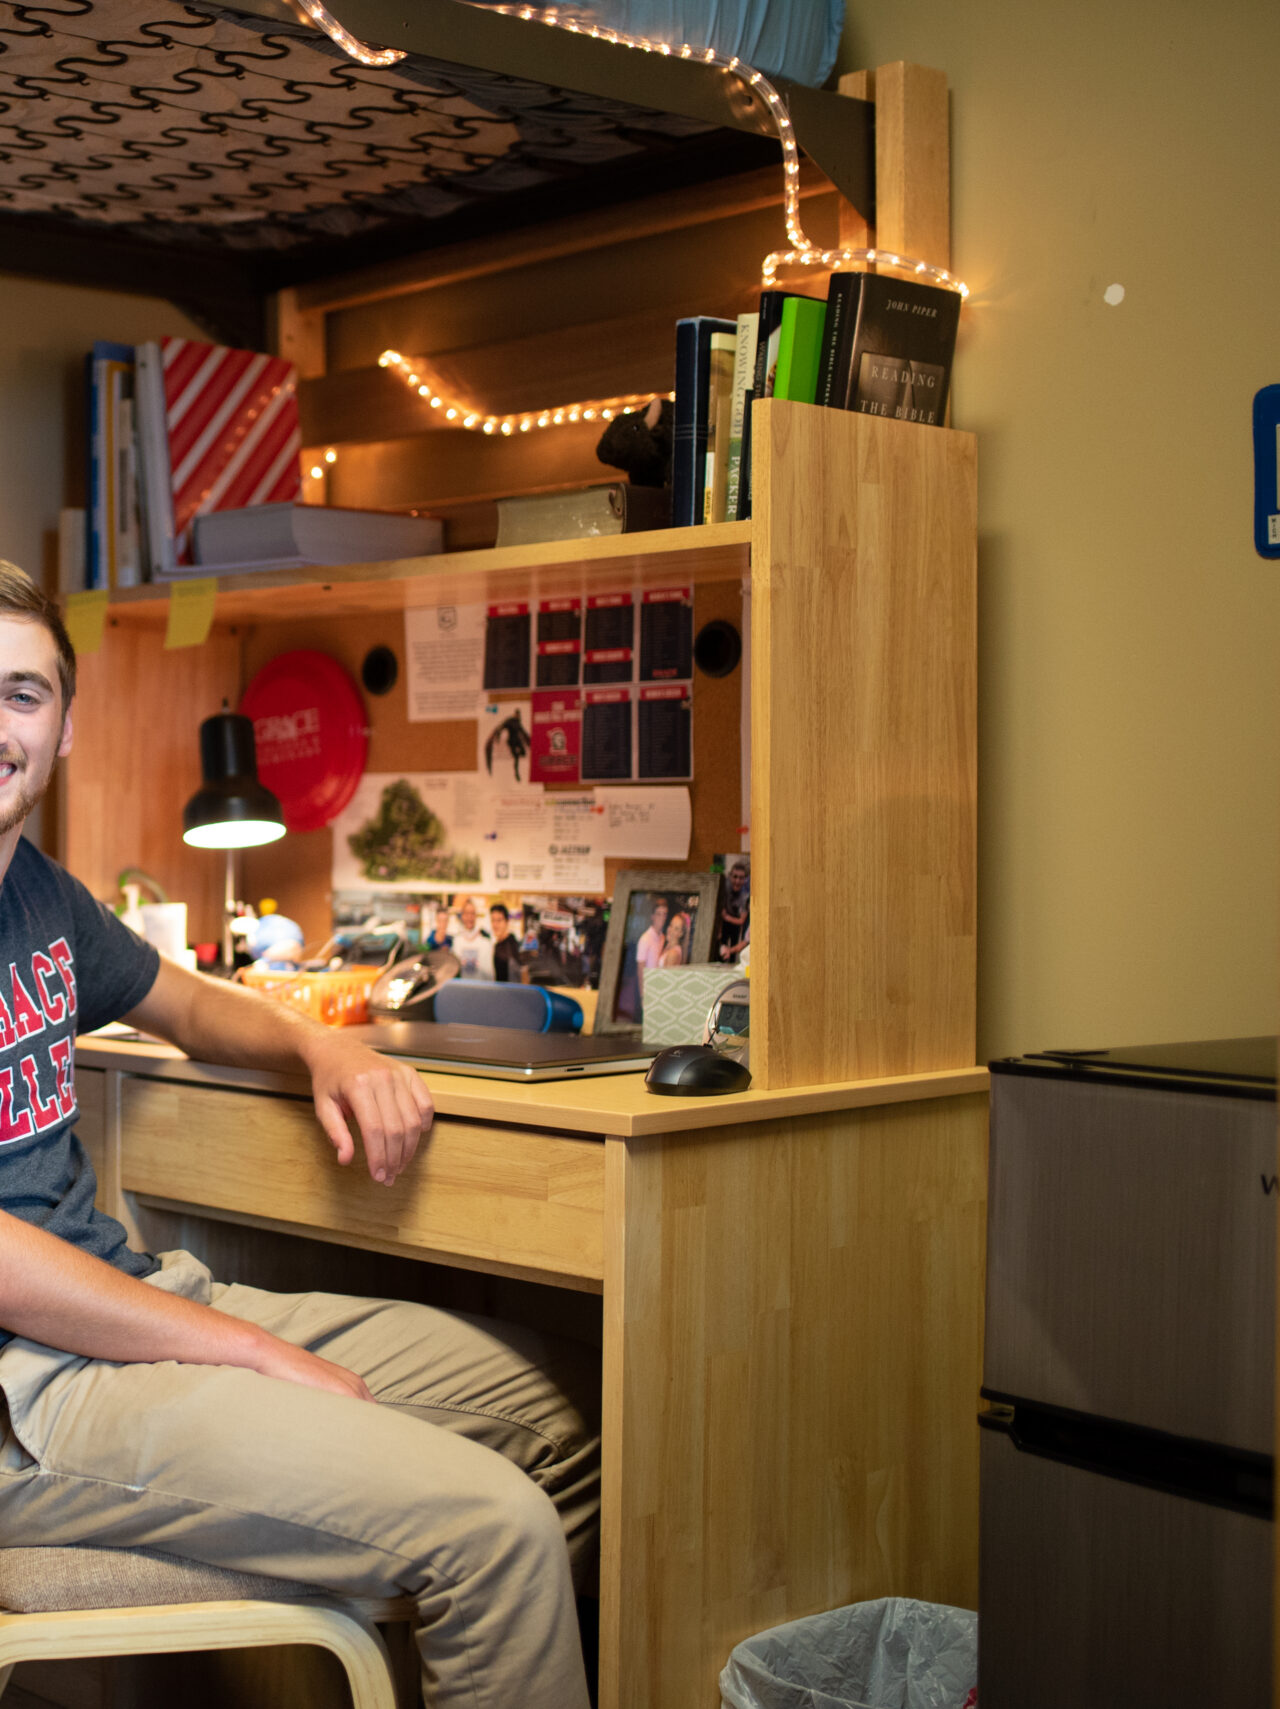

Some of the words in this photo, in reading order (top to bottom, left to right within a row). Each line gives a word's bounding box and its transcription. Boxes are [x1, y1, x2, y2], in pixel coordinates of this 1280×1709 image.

[886, 299, 910, 313] JOHN
[912, 304, 938, 319] PIPER
[735, 323, 750, 399] KNOWING
[871, 365, 936, 389] READING
[733, 401, 746, 435] GOD
[861, 399, 888, 418] THE
[895, 401, 935, 424] BIBLE
[727, 455, 741, 515] PACKER
